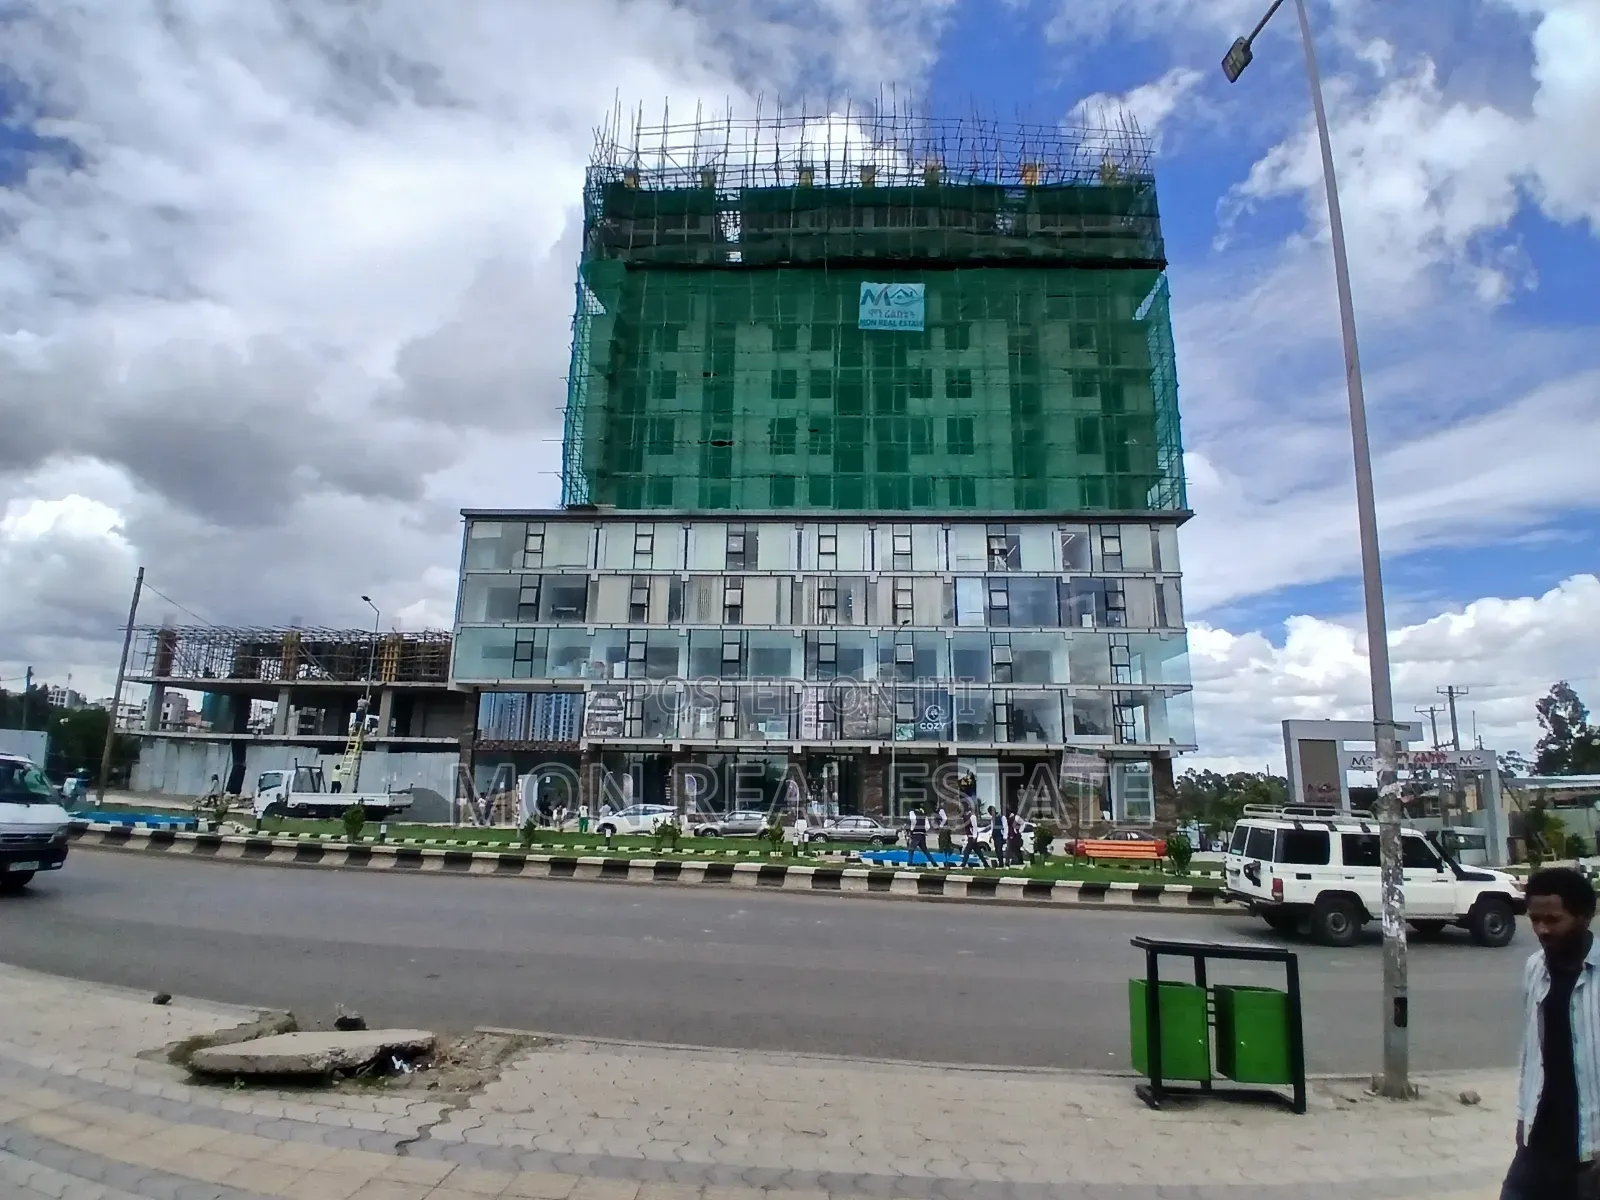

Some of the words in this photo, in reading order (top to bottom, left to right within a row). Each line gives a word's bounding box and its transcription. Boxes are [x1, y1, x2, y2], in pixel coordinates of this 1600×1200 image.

[860, 318, 878, 327] MON
[879, 319, 897, 328] REAL
[920, 722, 946, 730] COZY
